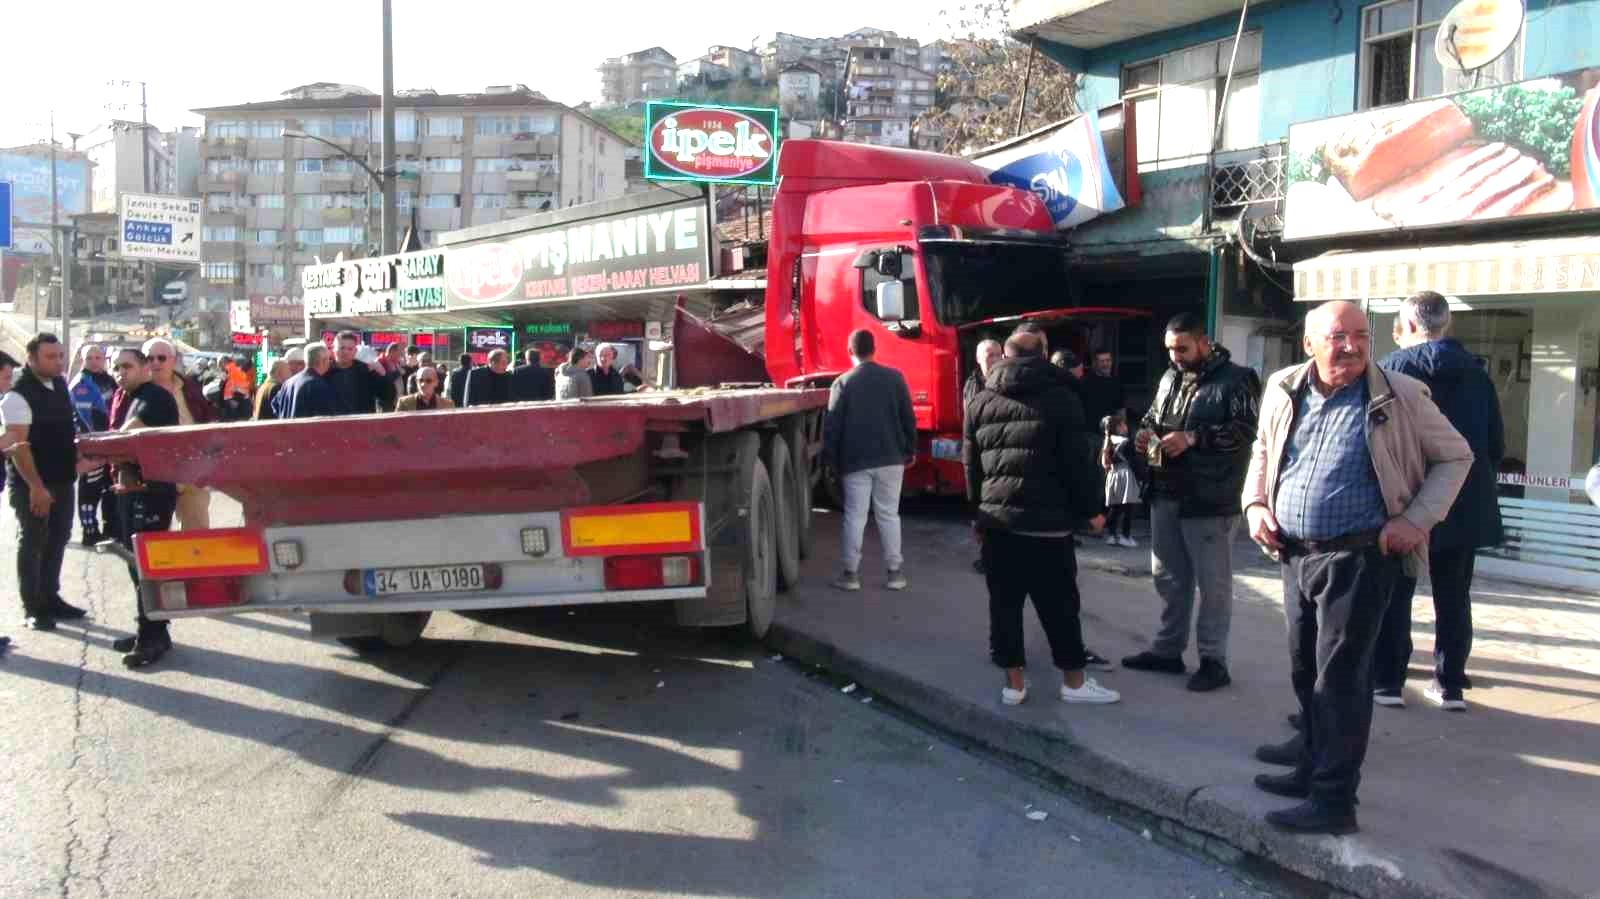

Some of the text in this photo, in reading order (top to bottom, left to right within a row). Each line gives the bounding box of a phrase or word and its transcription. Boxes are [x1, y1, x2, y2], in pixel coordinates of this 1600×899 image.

[127, 222, 171, 233] Ankara
[377, 567, 398, 592] 34
[409, 568, 433, 591] UA
